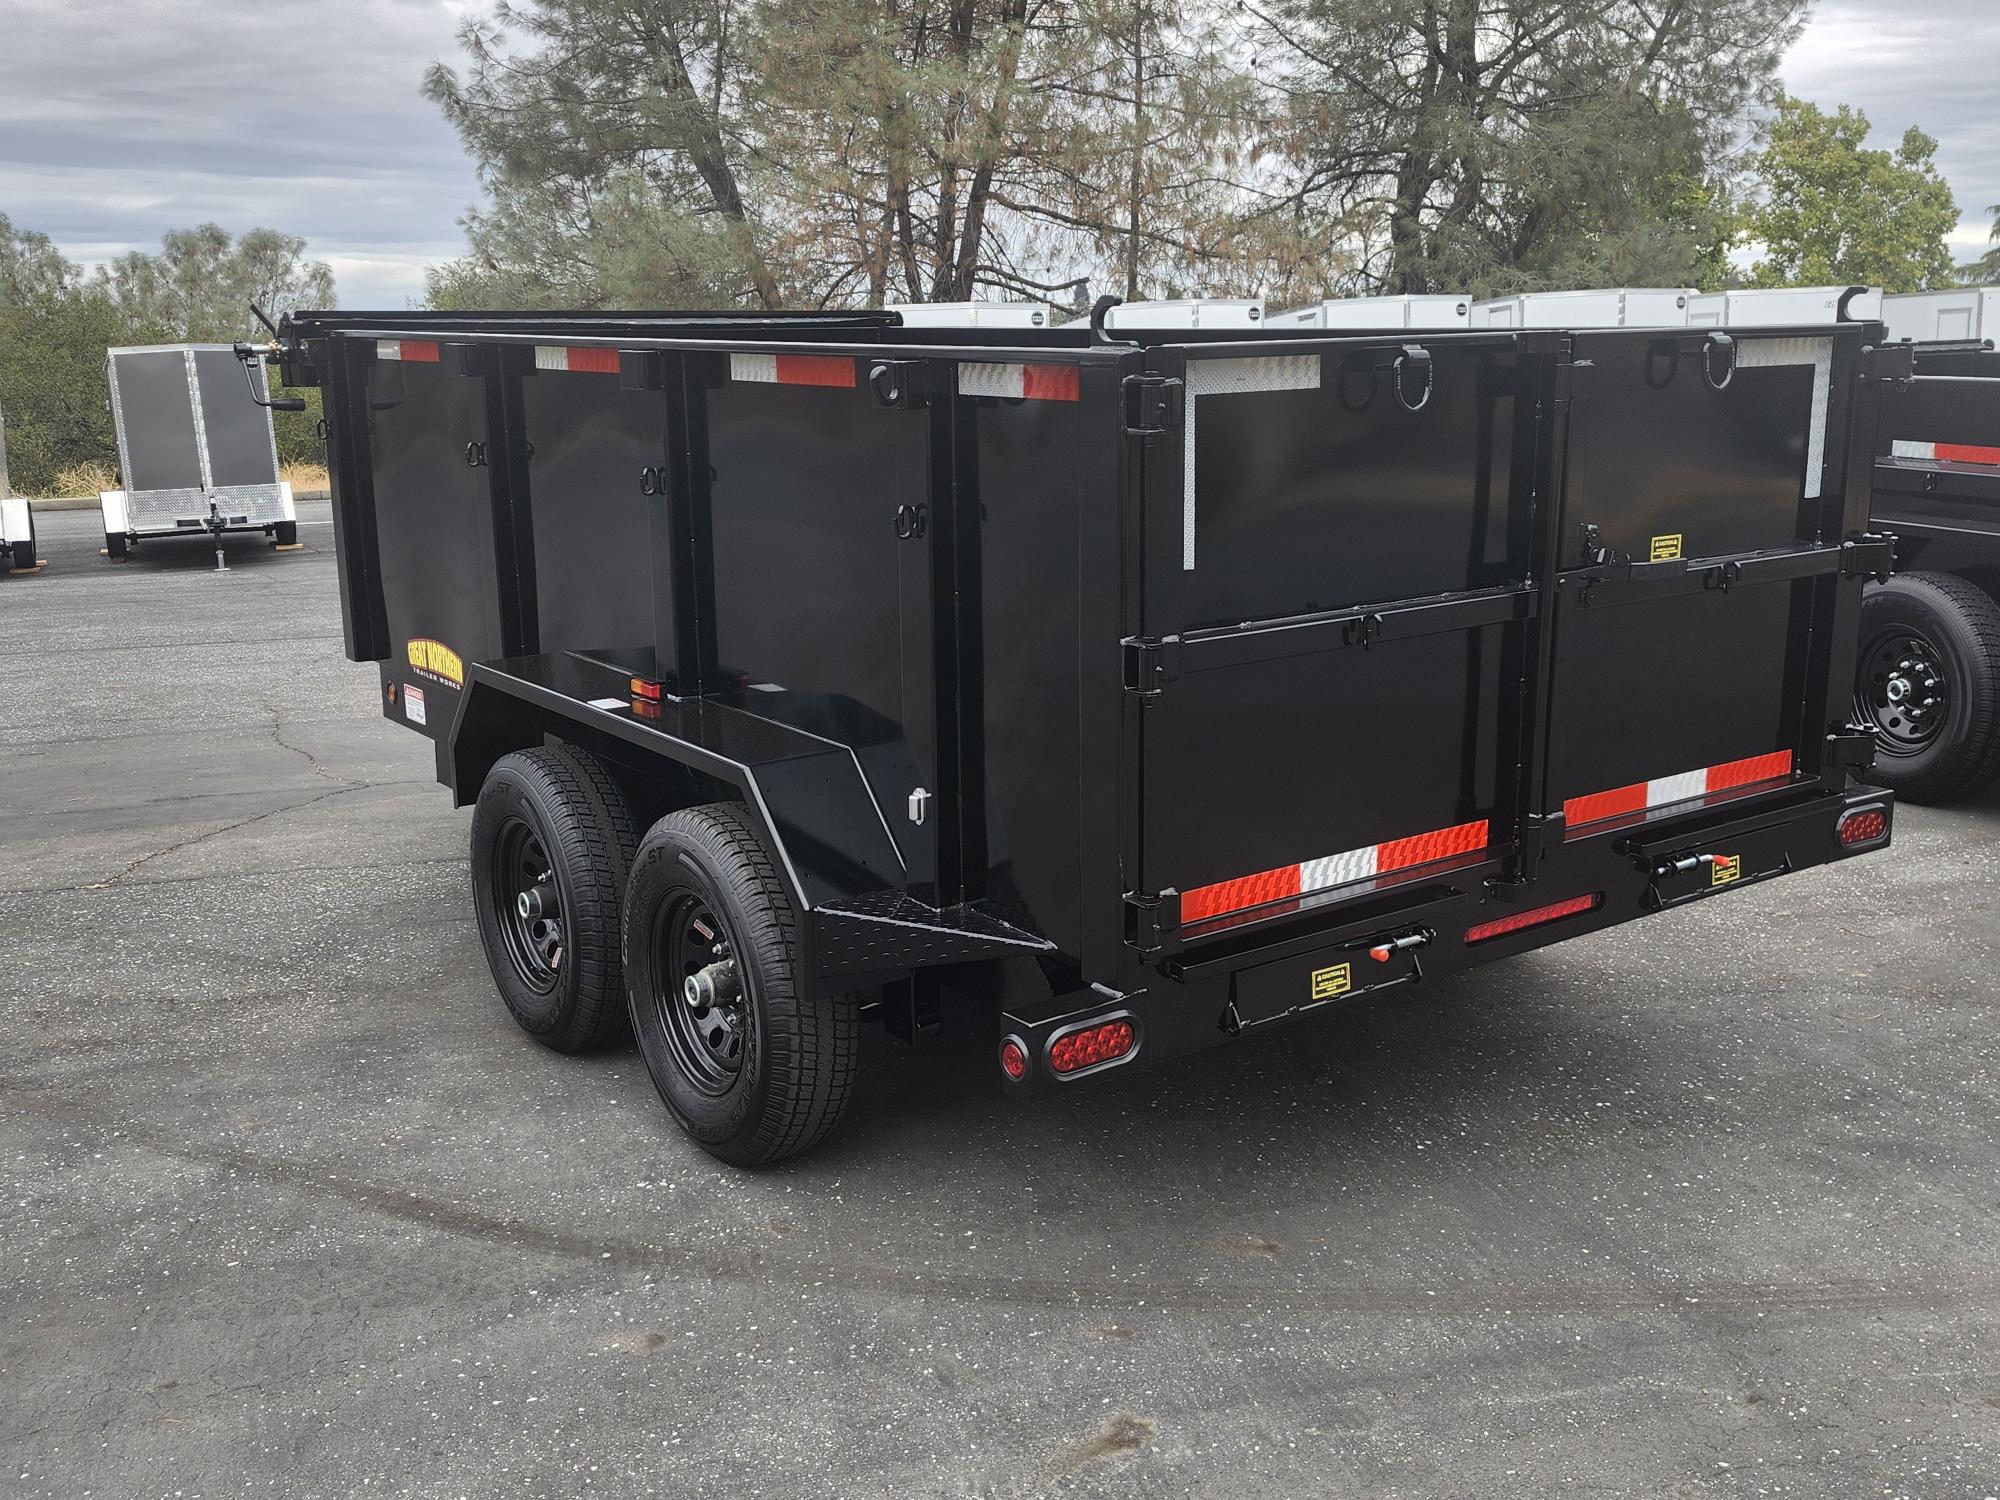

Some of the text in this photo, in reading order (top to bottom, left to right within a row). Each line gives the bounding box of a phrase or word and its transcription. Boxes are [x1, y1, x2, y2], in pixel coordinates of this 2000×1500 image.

[407, 640, 463, 684] GREAT NORTHERN
[413, 667, 461, 691] TRAILER WORKS
